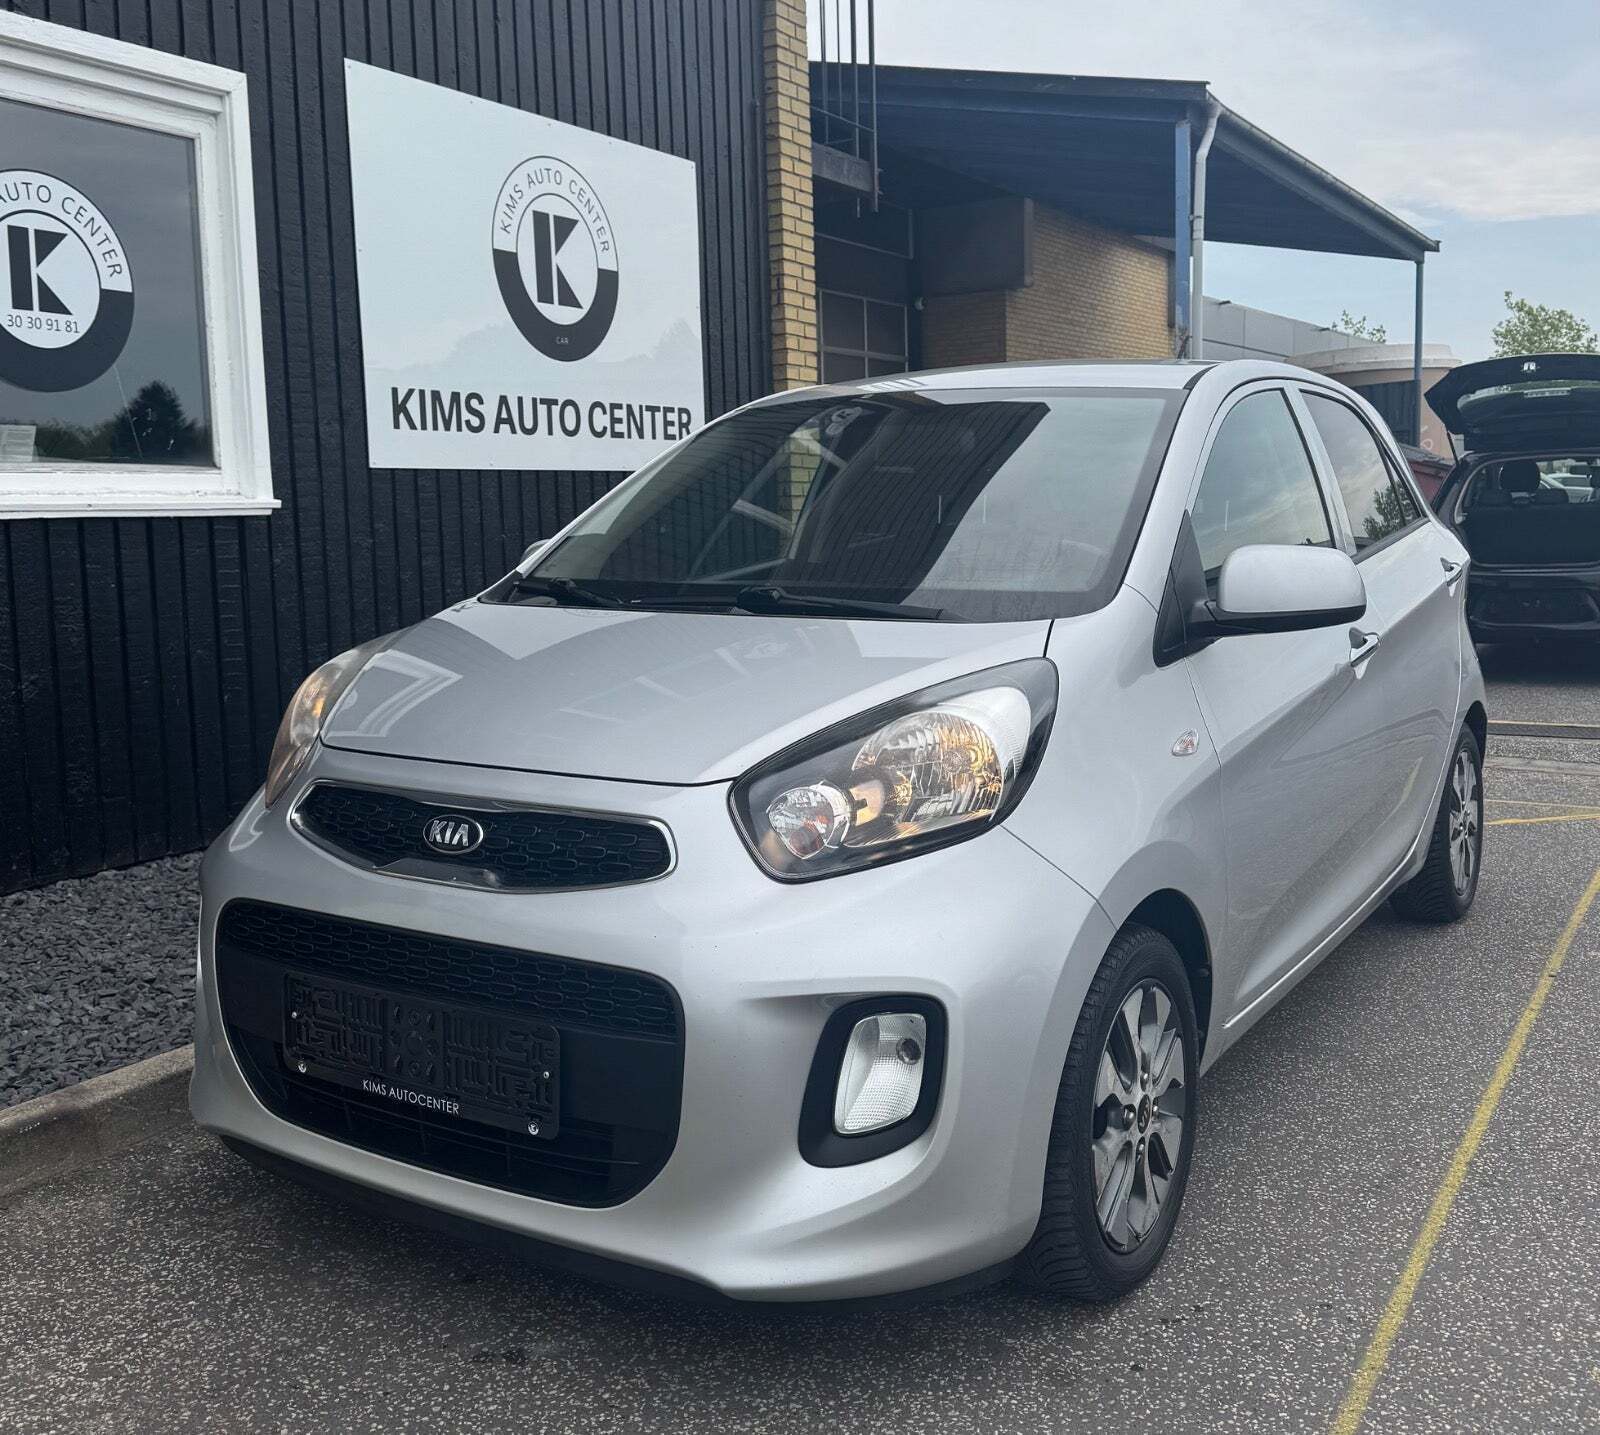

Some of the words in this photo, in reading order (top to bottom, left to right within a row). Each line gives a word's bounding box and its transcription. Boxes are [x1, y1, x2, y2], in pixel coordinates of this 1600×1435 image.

[500, 184, 524, 234] KIMS
[527, 168, 562, 188] AUTO
[569, 180, 610, 252] CENTER
[61, 196, 123, 277] CENTER
[7, 314, 23, 328] 30
[27, 316, 42, 330] 30
[46, 318, 61, 332] 91
[65, 320, 80, 333] 81
[391, 387, 486, 434] KIMS
[493, 394, 581, 437] AUTO
[588, 400, 692, 441] CENTER
[428, 820, 469, 847] KIA
[362, 1079, 387, 1096] KIMS
[388, 1087, 460, 1115] AUTOCENTER
